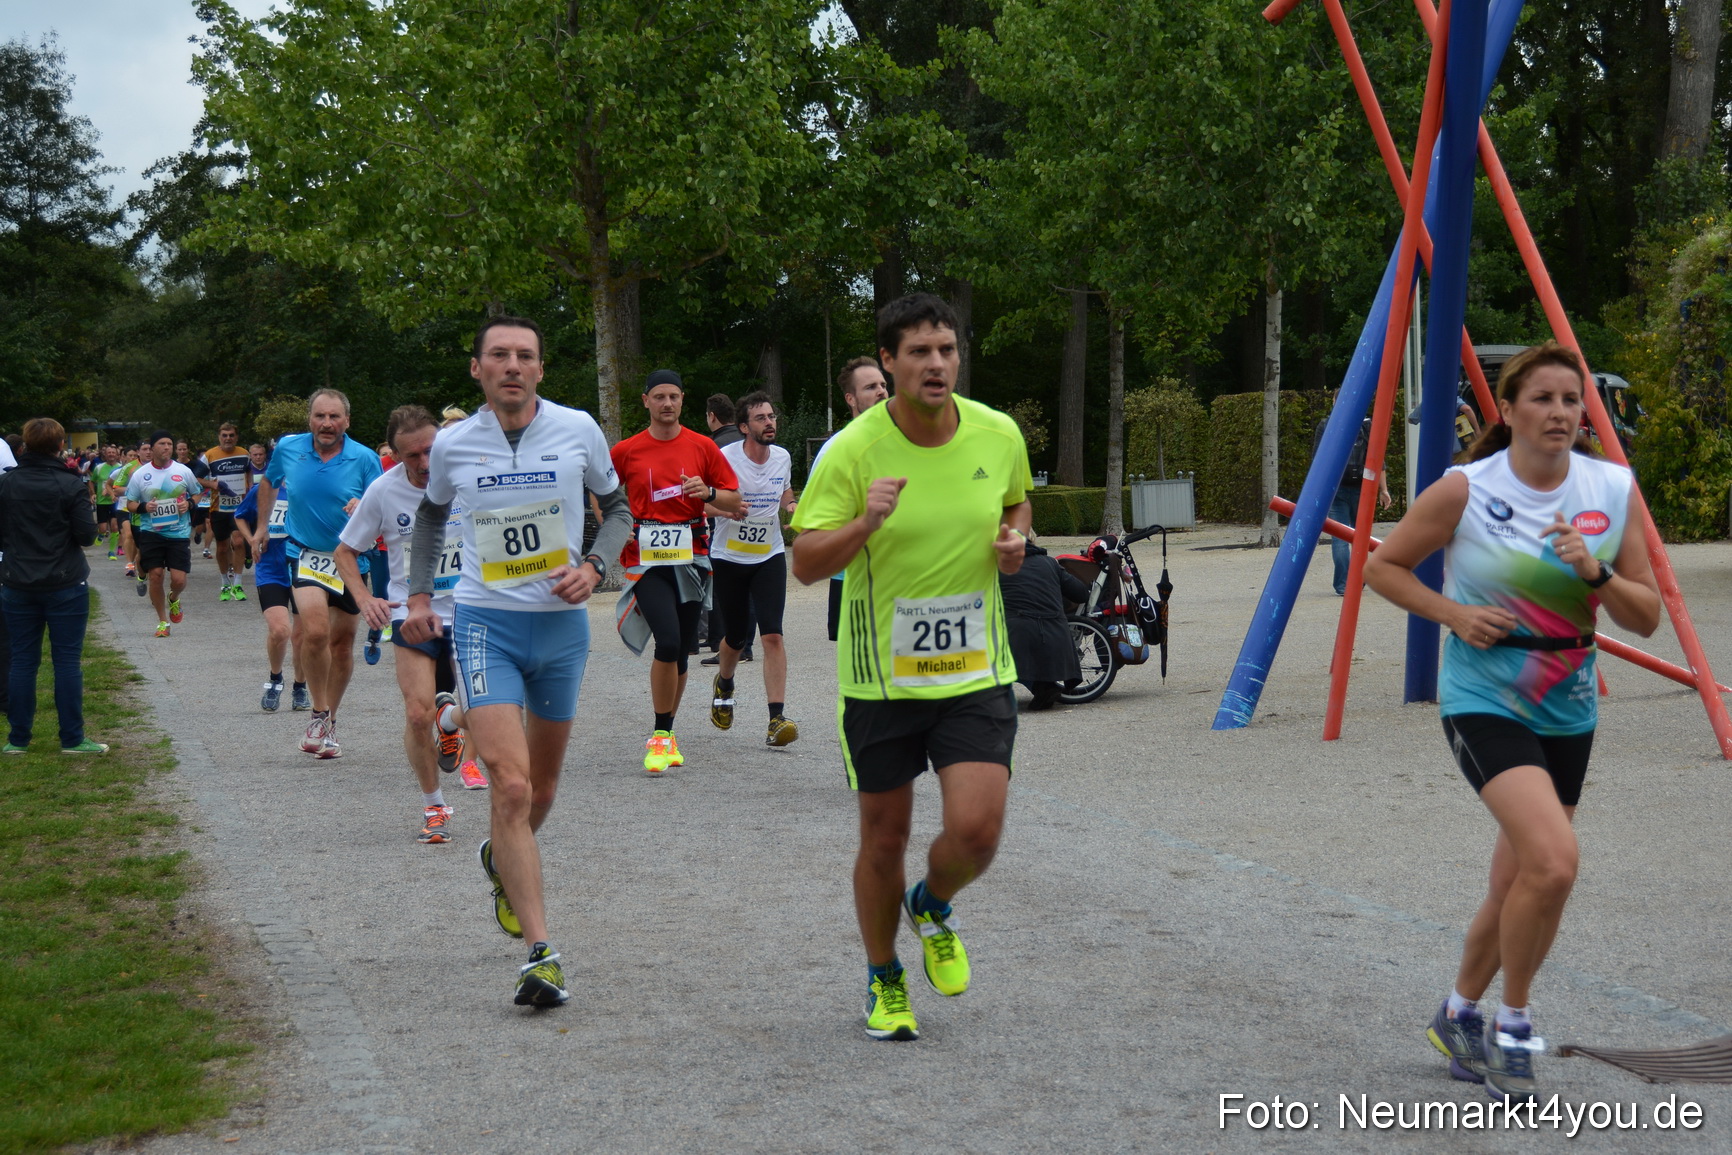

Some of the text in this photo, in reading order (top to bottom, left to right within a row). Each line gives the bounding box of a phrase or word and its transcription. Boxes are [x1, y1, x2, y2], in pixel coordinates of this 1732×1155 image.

[475, 508, 547, 526] PARTL Neumarkt
[503, 523, 541, 556] 80
[650, 529, 682, 548] 237
[738, 525, 767, 543] 532
[653, 551, 680, 559] Michael
[506, 558, 548, 576] Helmut
[897, 603, 972, 616] PARTL Neumarkt
[913, 616, 967, 651] 261
[917, 656, 966, 673] Michael
